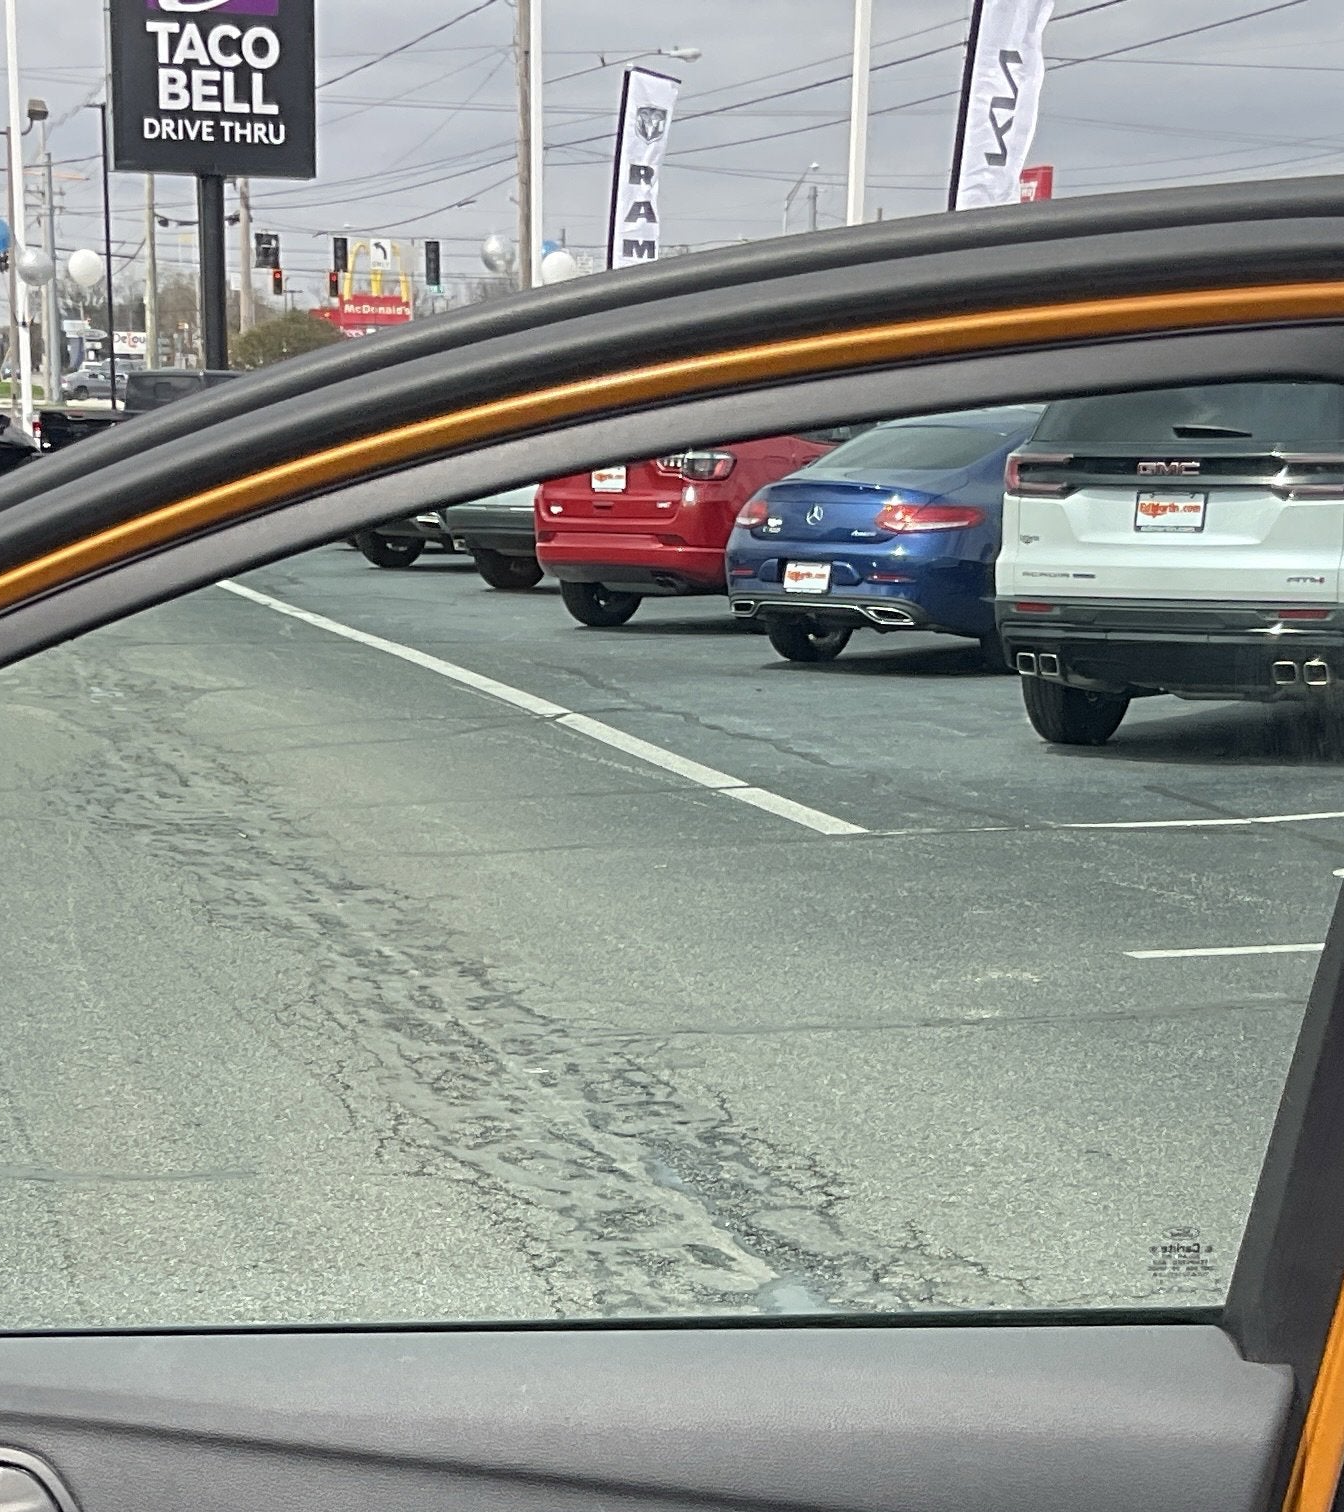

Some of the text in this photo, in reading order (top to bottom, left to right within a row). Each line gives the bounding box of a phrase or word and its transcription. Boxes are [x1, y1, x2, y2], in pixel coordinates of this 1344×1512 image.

[145, 19, 281, 70] TACO
[157, 67, 280, 115] BELL
[143, 117, 287, 145] DRIVE THRU
[622, 163, 658, 259] RAM
[343, 304, 411, 315] McDonald's
[1136, 461, 1201, 476] GMC
